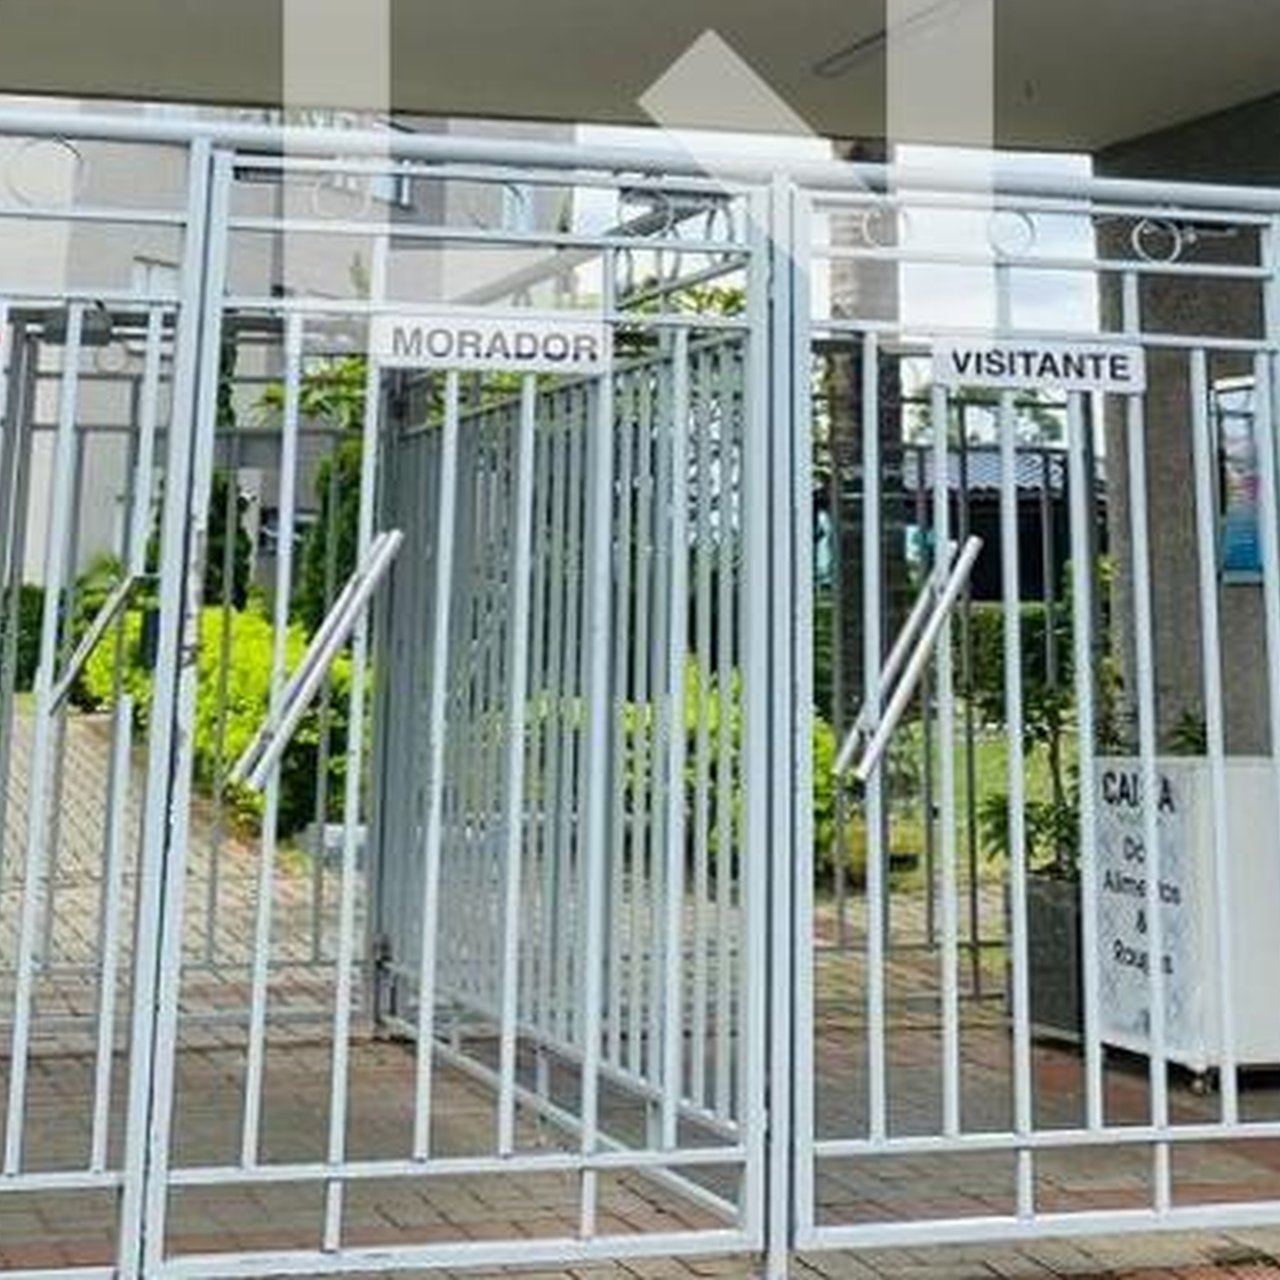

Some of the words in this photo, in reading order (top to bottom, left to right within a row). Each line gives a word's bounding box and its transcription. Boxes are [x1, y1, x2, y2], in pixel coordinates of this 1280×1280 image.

[391, 326, 599, 363] MORADOR
[950, 347, 1132, 382] VISITANTE
[1102, 769, 1176, 815] CAIA
[1102, 868, 1182, 907] Alimetos
